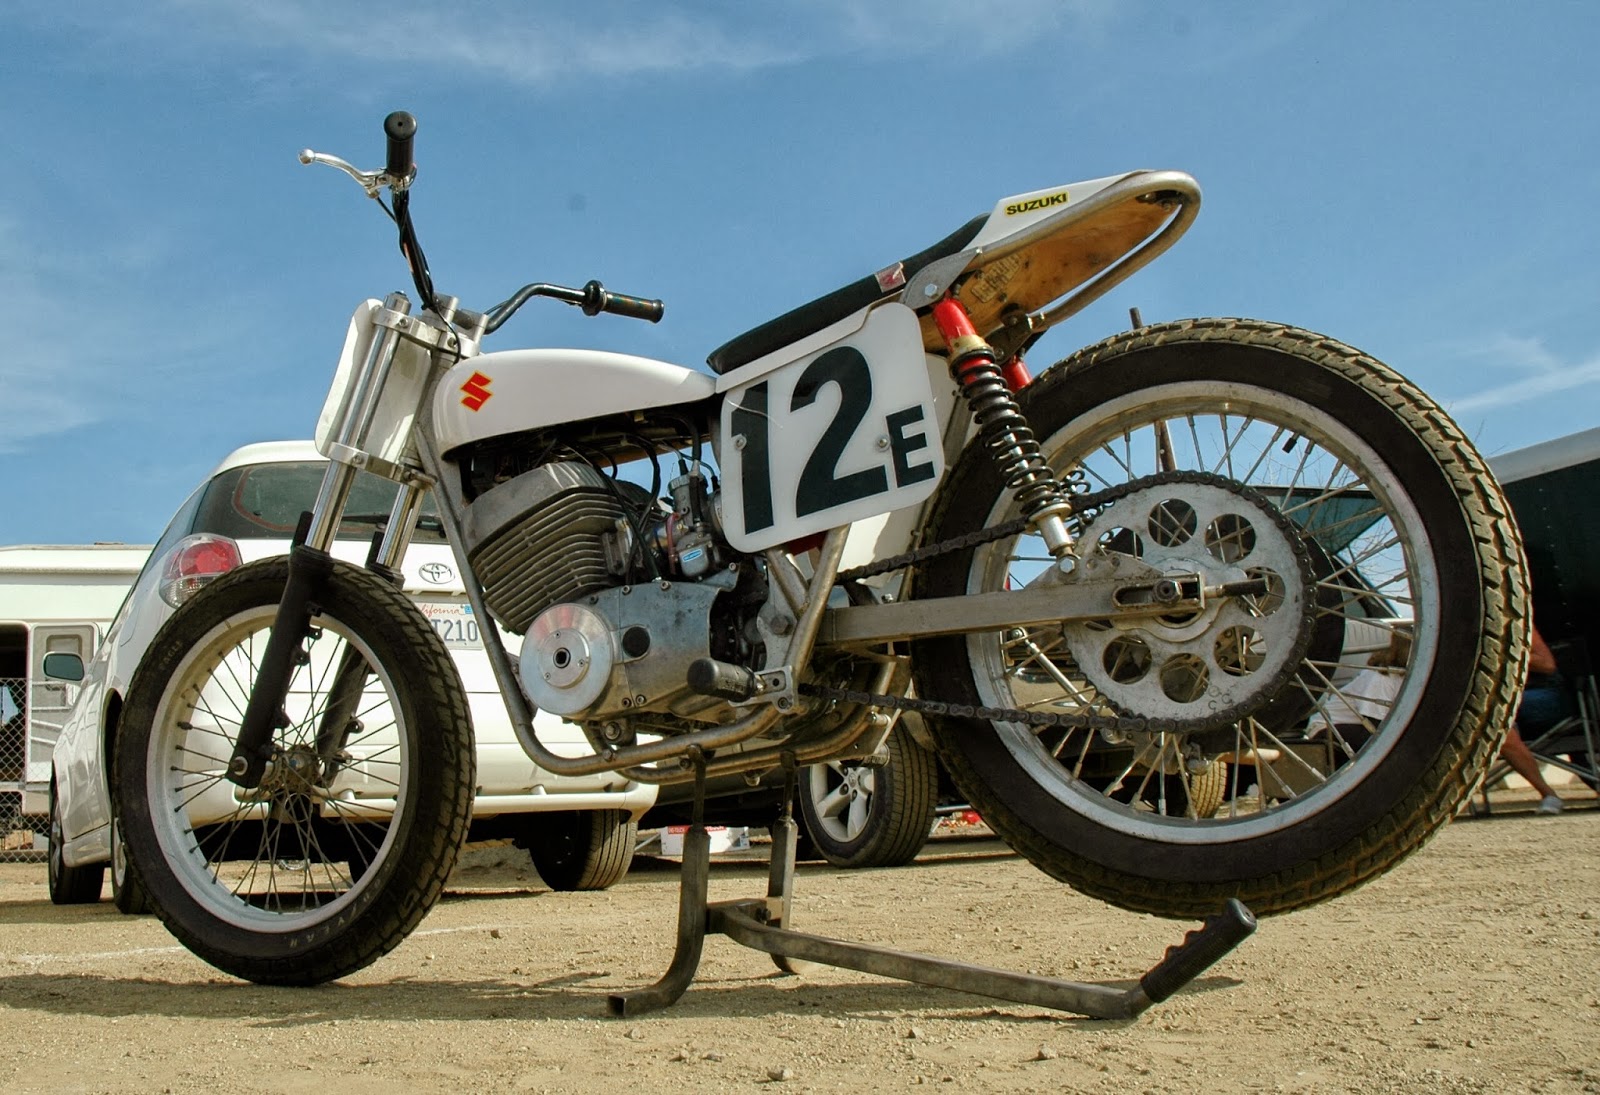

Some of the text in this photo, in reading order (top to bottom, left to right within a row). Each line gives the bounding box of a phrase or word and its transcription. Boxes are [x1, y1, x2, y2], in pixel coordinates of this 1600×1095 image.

[1005, 192, 1067, 216] SUZUKI
[420, 603, 461, 618] lifornia
[430, 618, 479, 642] T210
